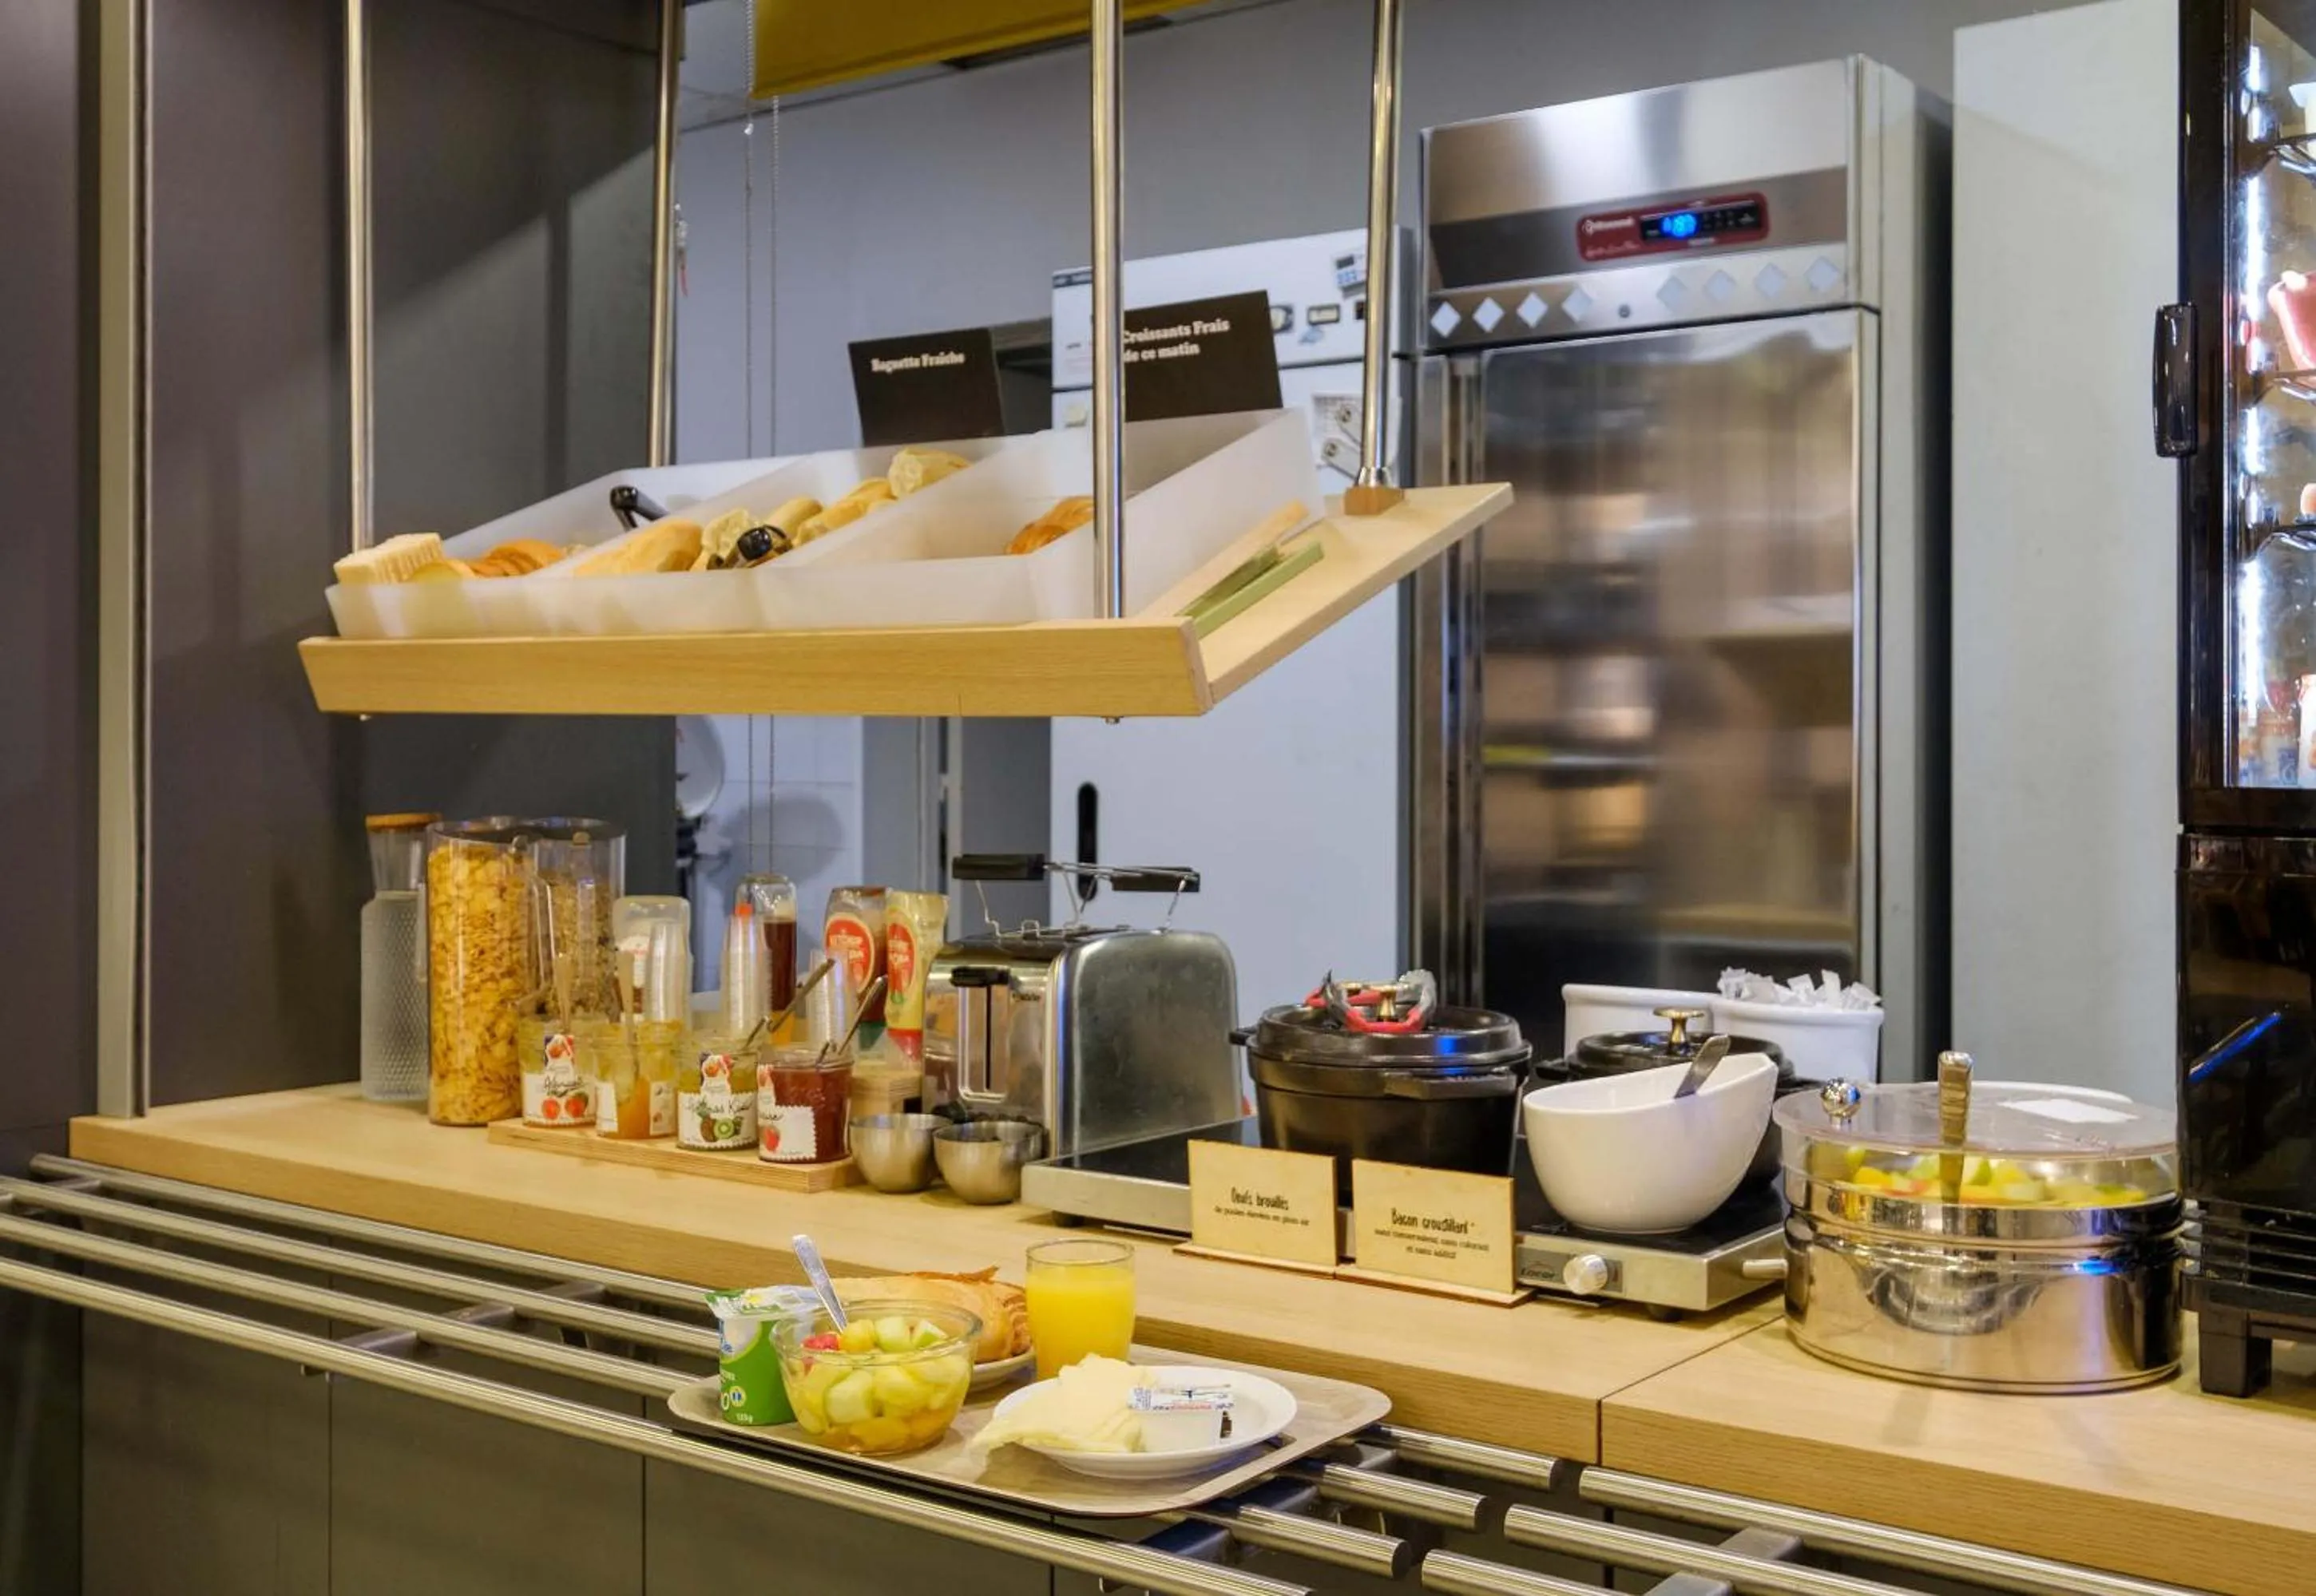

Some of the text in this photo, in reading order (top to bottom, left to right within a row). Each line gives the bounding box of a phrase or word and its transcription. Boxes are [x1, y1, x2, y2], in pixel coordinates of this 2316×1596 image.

[1124, 317, 1230, 344] Croissants Frais
[1123, 341, 1200, 362] de ce matin
[1391, 1207, 1418, 1227] Bacon
